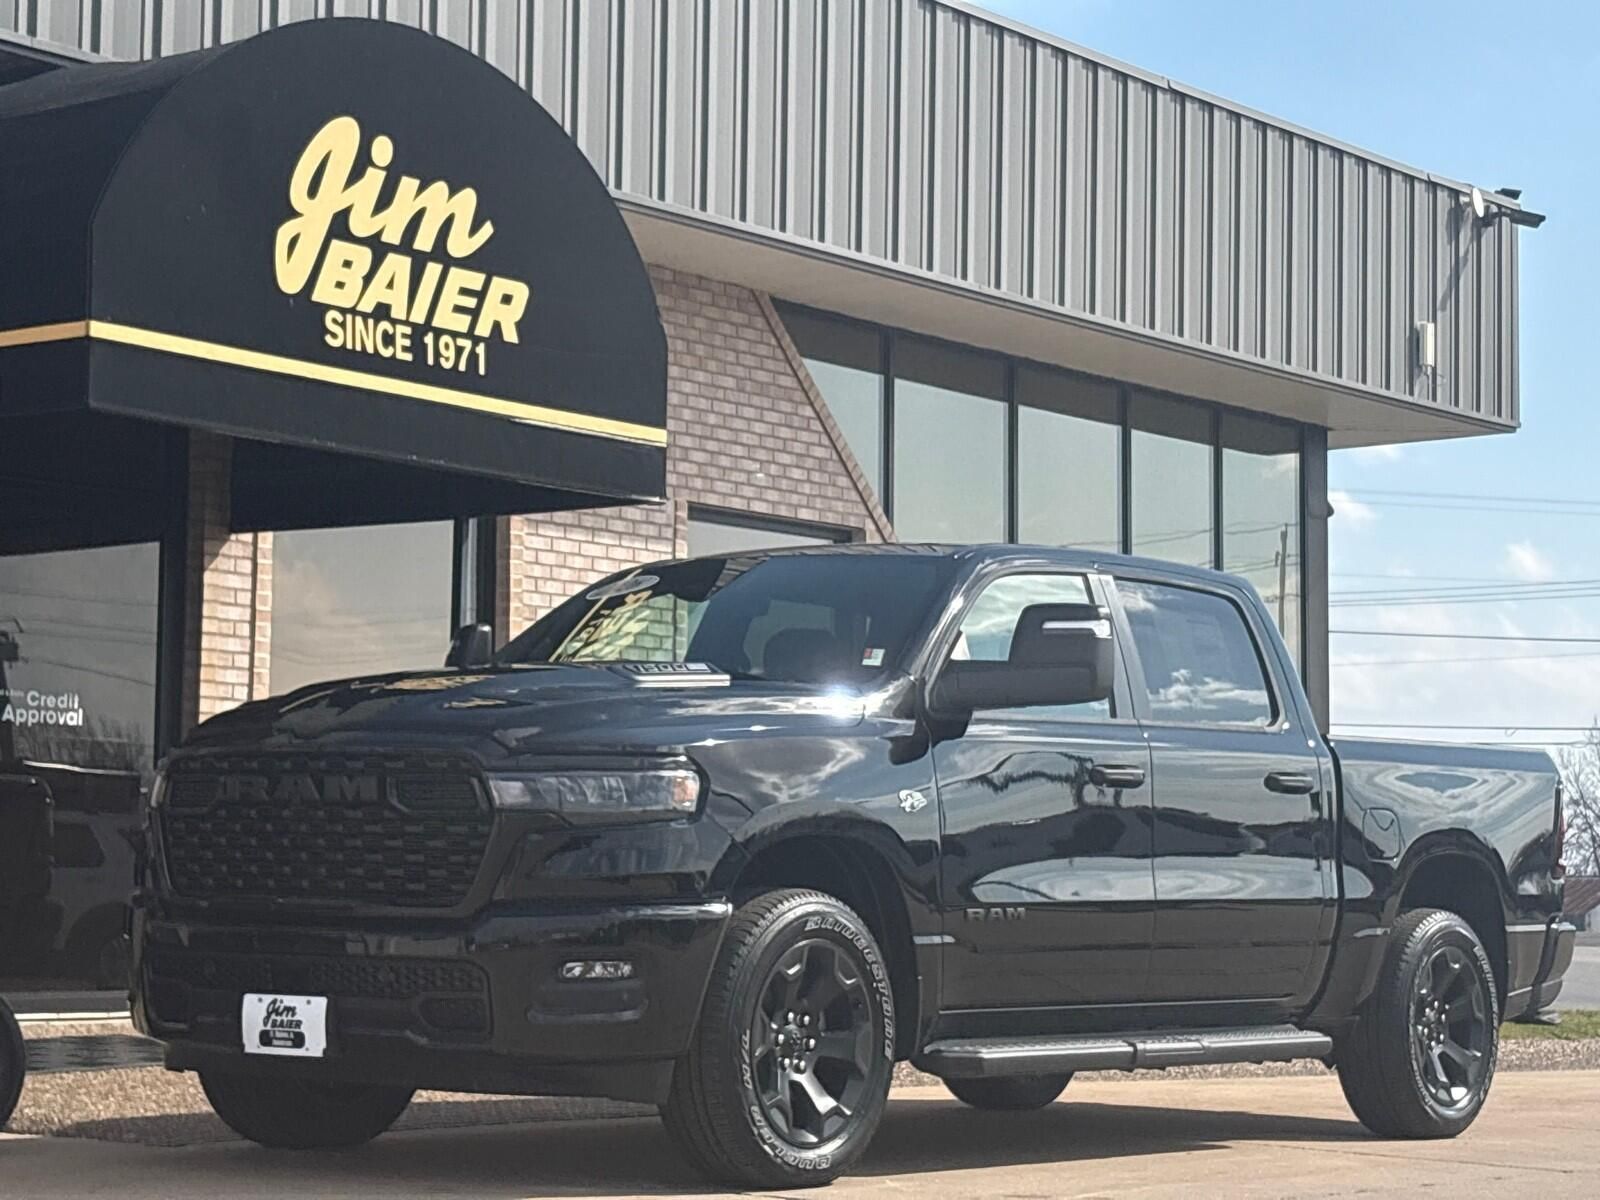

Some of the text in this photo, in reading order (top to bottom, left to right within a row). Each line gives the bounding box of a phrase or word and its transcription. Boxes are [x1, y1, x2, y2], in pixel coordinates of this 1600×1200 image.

[275, 115, 494, 295] Jim
[311, 239, 530, 344] BAIER
[324, 310, 486, 376] SINCE 1971
[26, 690, 79, 709] Credit
[1, 703, 84, 727] Approval
[226, 774, 379, 801] RAM
[964, 907, 1026, 921] RAM
[263, 997, 298, 1028] Jim
[270, 1018, 303, 1030] BAIER
